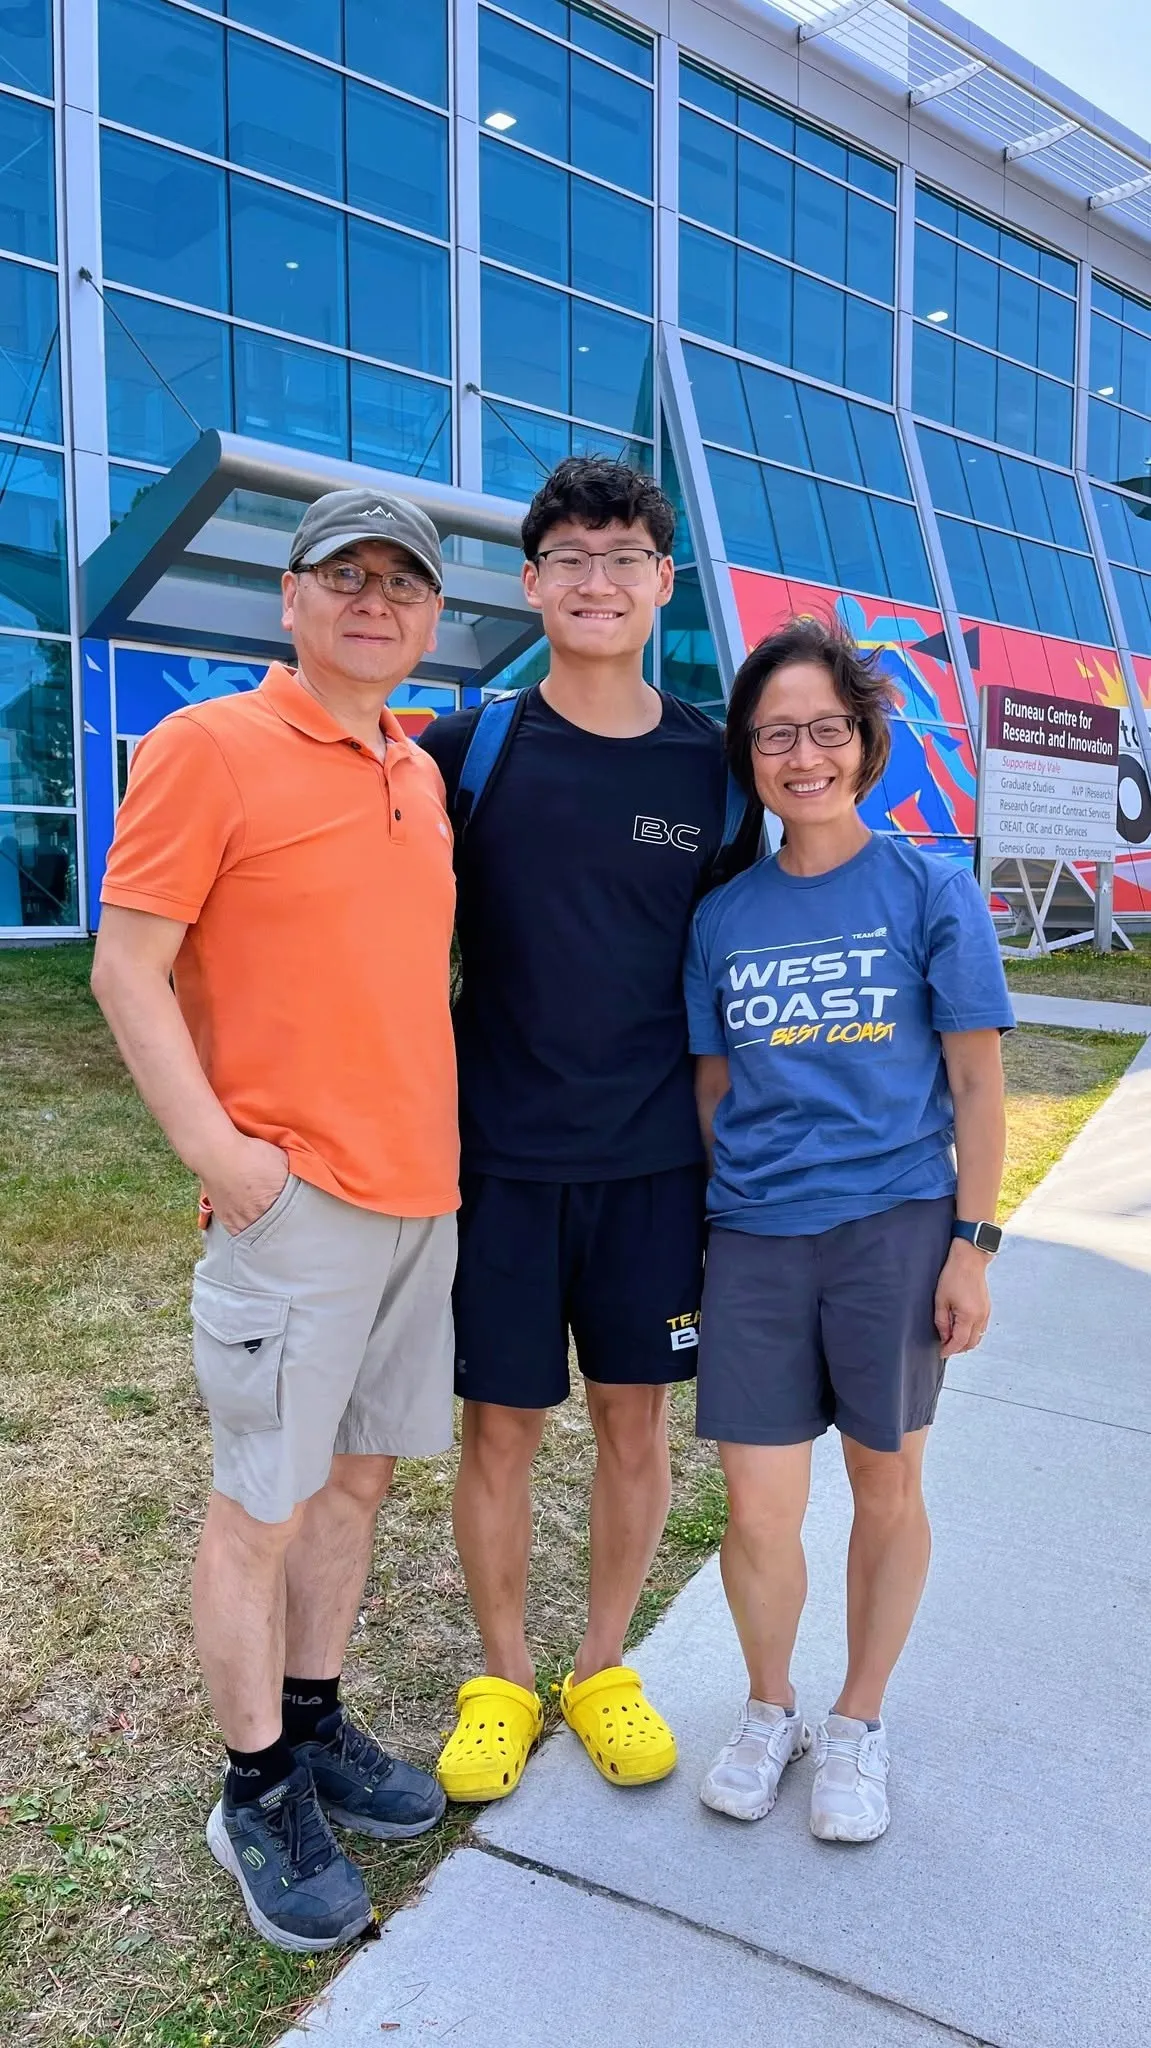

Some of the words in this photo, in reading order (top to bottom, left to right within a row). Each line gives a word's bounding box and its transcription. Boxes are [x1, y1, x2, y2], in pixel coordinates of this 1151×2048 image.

[1004, 697, 1044, 722] Bruneau
[1047, 705, 1077, 728] Centre
[1079, 710, 1093, 730] for
[1003, 722, 1045, 746] Research
[1048, 730, 1066, 749] and
[1067, 732, 1113, 756] Innovation
[1002, 755, 1037, 771] Supported
[1038, 760, 1046, 775] by
[1047, 761, 1061, 774] Vale
[1001, 777, 1031, 791] Graduate
[1032, 780, 1056, 794] Studies
[1071, 785, 1084, 796] AVP
[1085, 786, 1114, 801] (Research)
[999, 798, 1029, 812] Research
[1030, 801, 1048, 814] Grant
[1049, 803, 1061, 815] and
[1062, 804, 1088, 817] Contract
[1089, 807, 1111, 820] Services
[633, 815, 701, 852] BC
[1026, 822, 1039, 834] CRC
[1040, 824, 1053, 834] and
[1065, 825, 1088, 837] Services
[999, 841, 1024, 854] Genesis
[1025, 843, 1046, 857] Group
[1055, 844, 1077, 857] Process
[1078, 846, 1112, 861] Engineering
[729, 949, 887, 991] WEST
[726, 986, 898, 1030] COAST
[770, 1023, 825, 1046] BEST
[826, 1021, 897, 1044] COAST
